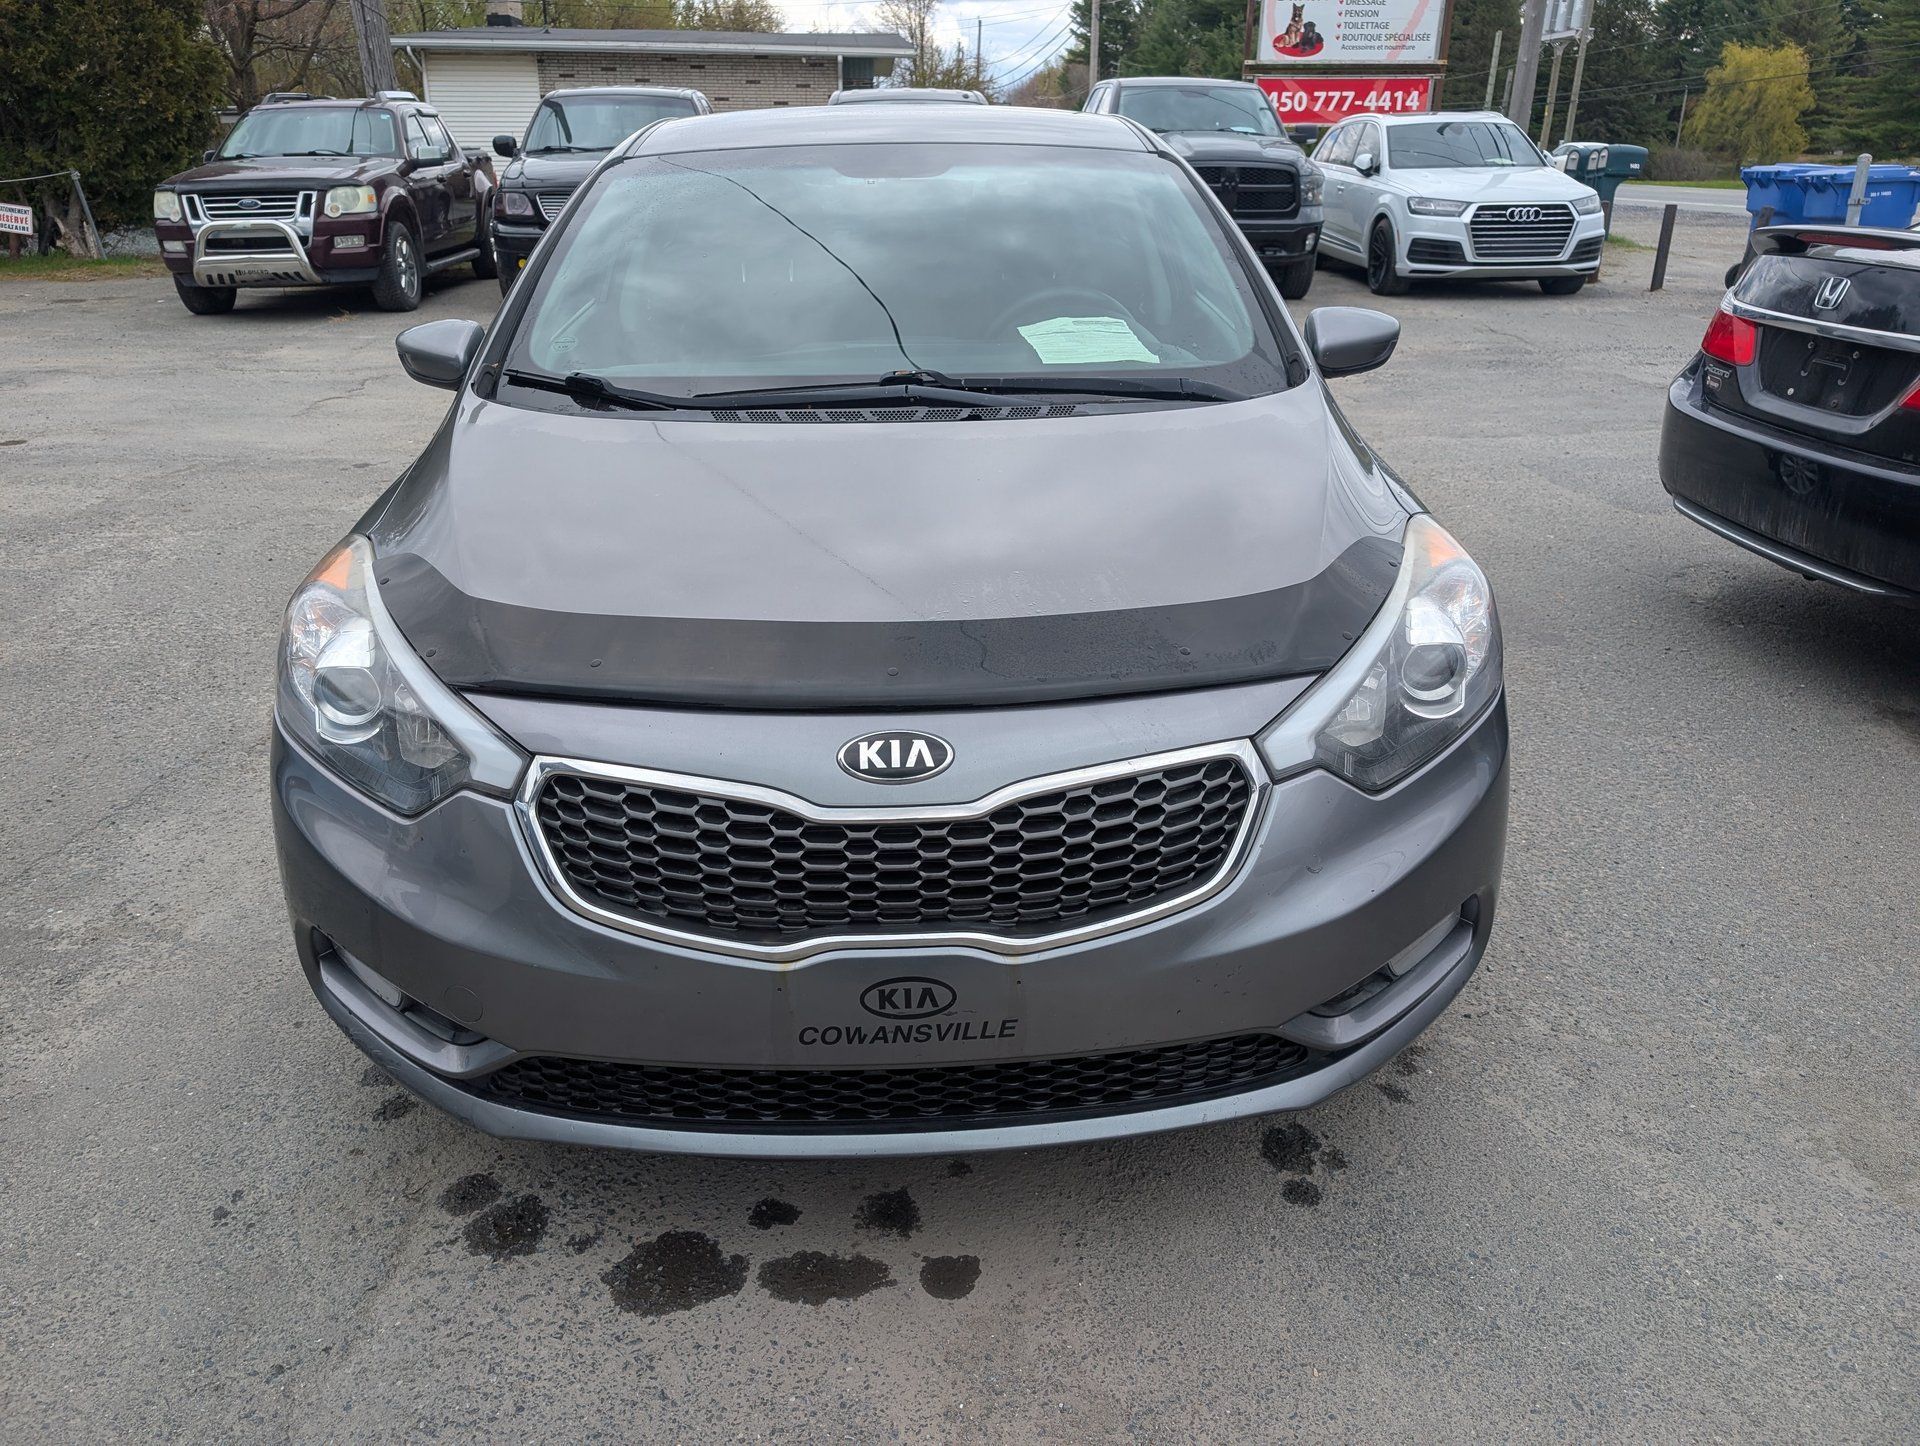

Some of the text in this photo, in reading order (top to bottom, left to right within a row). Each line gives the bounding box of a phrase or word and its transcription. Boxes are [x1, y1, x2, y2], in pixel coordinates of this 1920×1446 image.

[1344, 10, 1380, 18] PENSION
[1343, 21, 1390, 30] TOILETTAGE
[1342, 32, 1431, 42] BOUTIQUE SPÉCIALISÉE
[1268, 90, 1420, 112] 450 777-4414
[858, 740, 935, 770] KIA
[877, 987, 941, 1010] KIA
[799, 1019, 1019, 1046] COWANSVILLE
